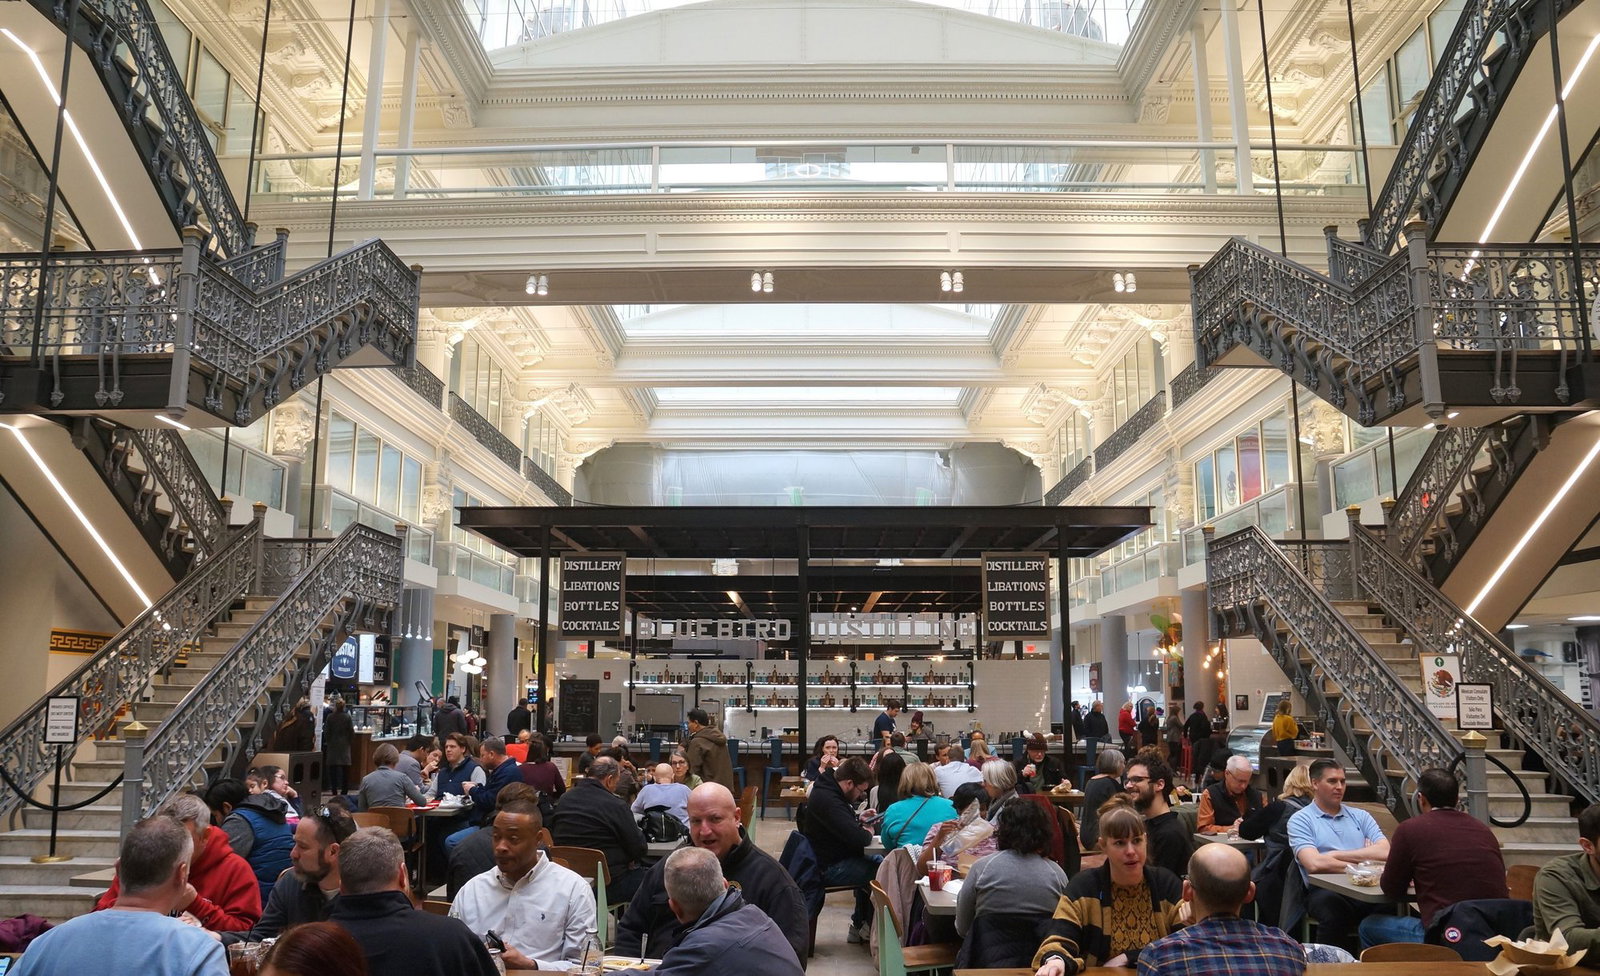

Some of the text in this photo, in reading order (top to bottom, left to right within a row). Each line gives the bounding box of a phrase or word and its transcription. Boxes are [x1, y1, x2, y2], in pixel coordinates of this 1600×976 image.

[564, 561, 621, 571] DISTILLERY
[986, 561, 1045, 571] DISTILLERY
[563, 581, 620, 591] LIBATIONS
[987, 581, 1046, 592] LIBATIONS
[564, 601, 619, 611] BOTTLES
[989, 601, 1045, 611] BOTTLES
[562, 621, 620, 631] COCKTAILS
[637, 619, 791, 641] BLUEBIRD
[988, 621, 1048, 631] COCKTAILS
